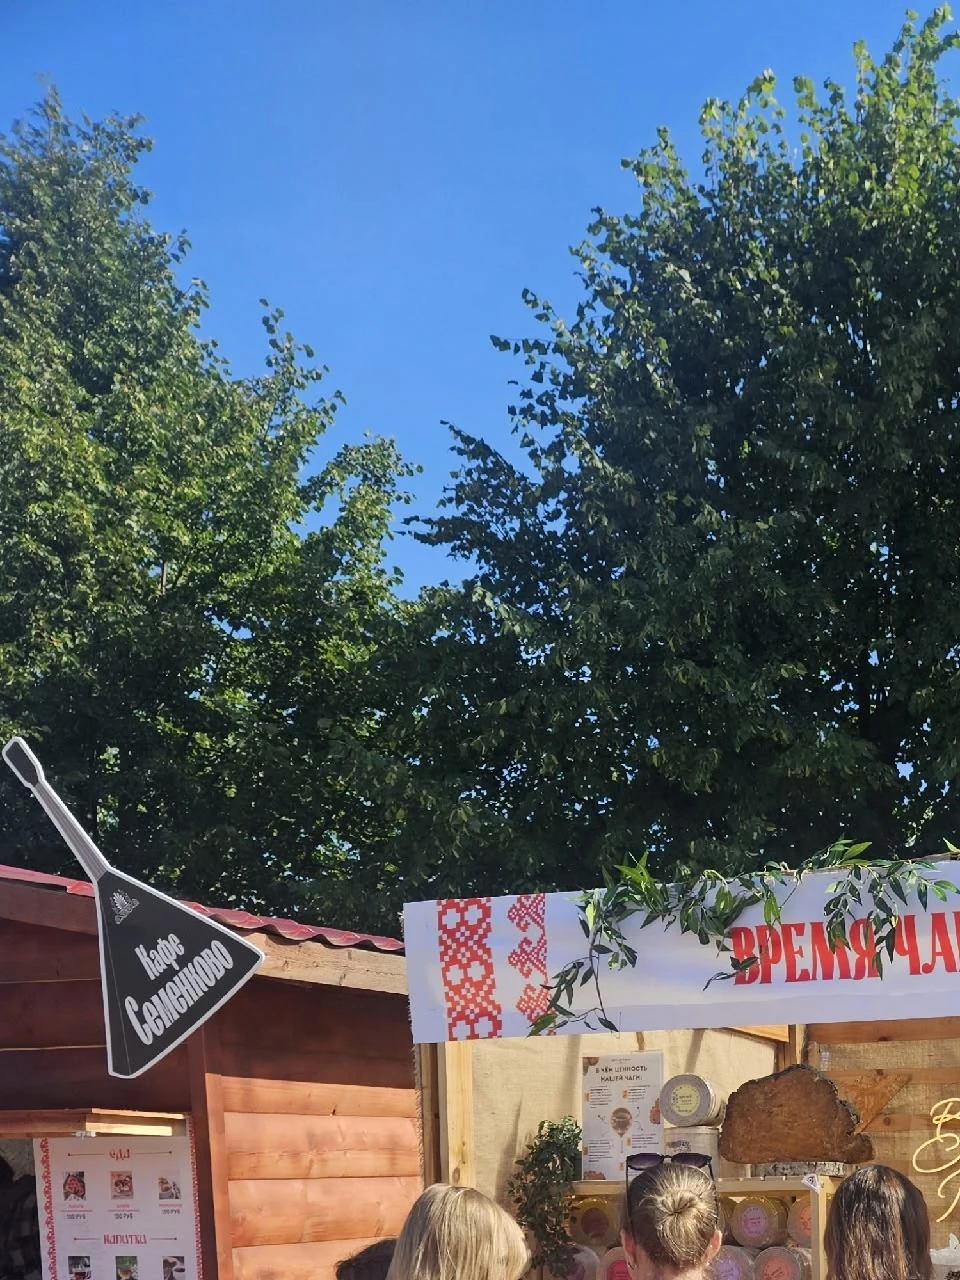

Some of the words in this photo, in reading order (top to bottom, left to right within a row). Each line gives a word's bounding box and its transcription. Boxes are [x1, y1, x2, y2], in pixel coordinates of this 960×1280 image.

[134, 933, 185, 980] Кафе
[731, 916, 882, 985] ВРЕМЯ
[124, 940, 234, 1045] Семенково
[615, 1065, 648, 1073] ЦЕННОСТЬ
